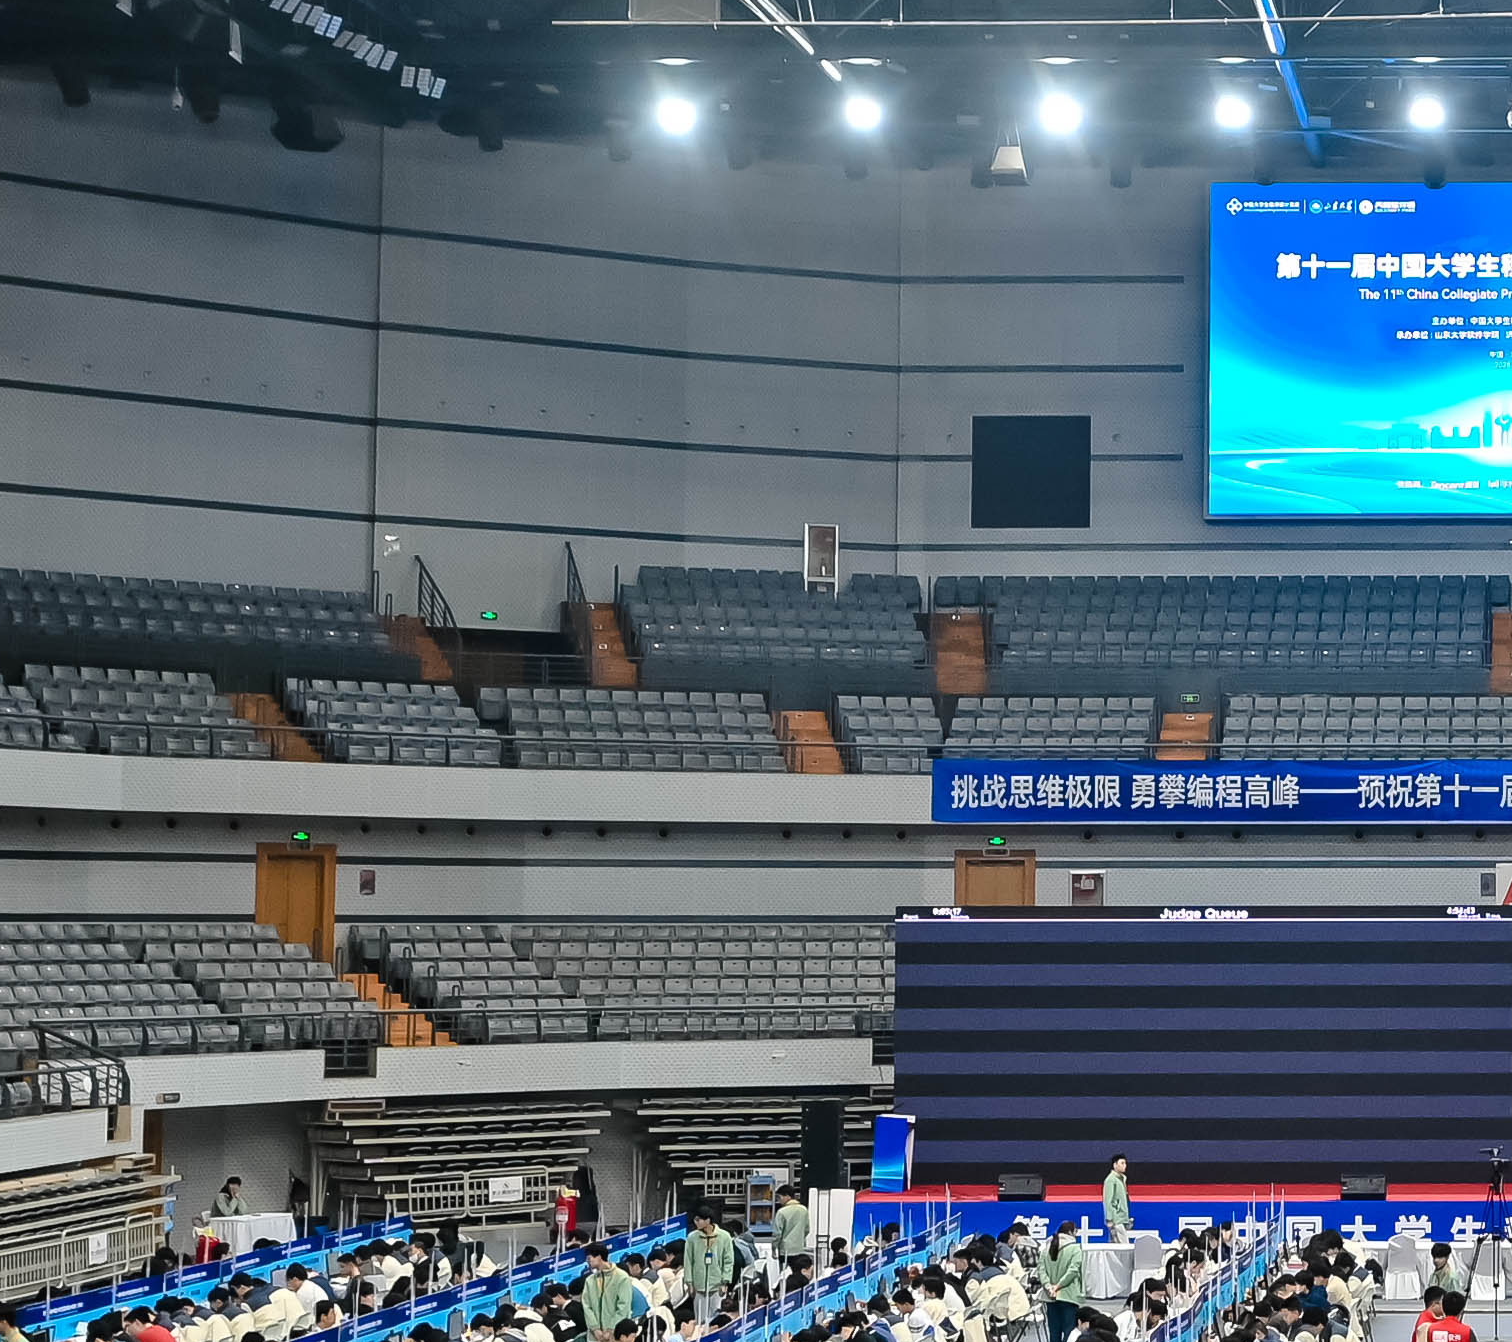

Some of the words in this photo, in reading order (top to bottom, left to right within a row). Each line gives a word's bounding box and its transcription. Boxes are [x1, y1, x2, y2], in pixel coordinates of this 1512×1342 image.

[1359, 288, 1380, 300] The
[1384, 288, 1404, 300] 11th
[1406, 288, 1438, 300] China
[1442, 288, 1498, 303] Collegiate
[950, 773, 1122, 812] 挑战思维极限
[1160, 907, 1202, 921] Judge
[1205, 907, 1249, 920] Queue
